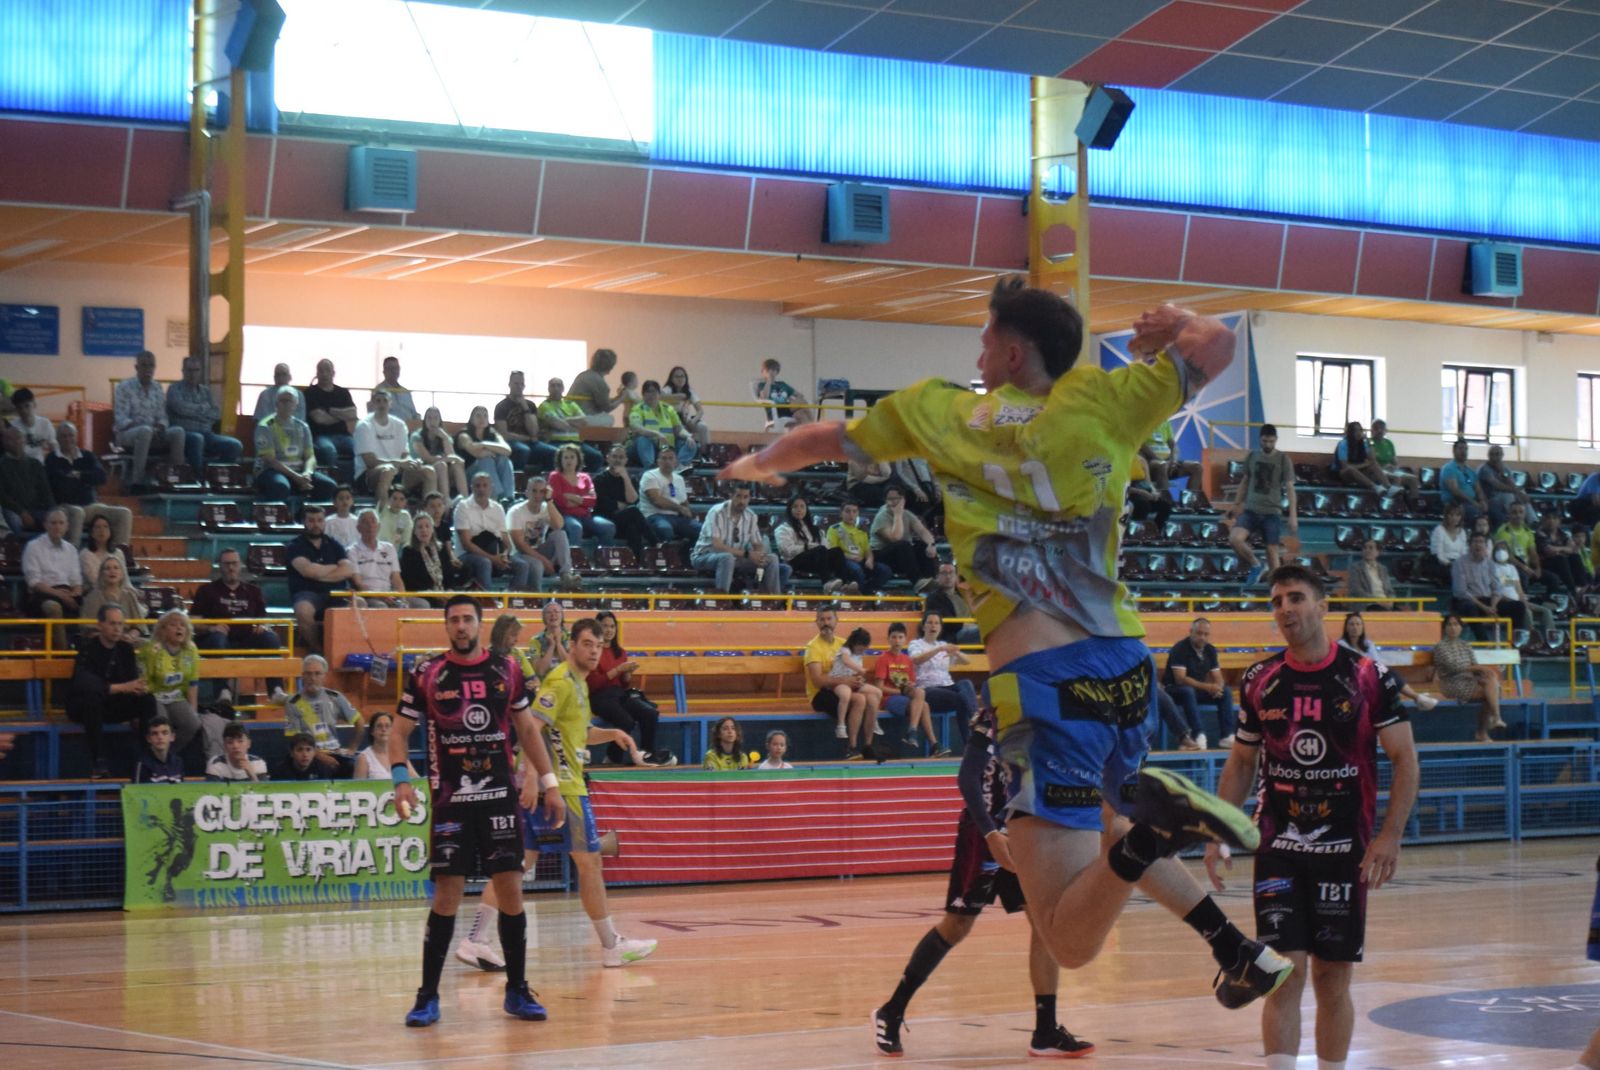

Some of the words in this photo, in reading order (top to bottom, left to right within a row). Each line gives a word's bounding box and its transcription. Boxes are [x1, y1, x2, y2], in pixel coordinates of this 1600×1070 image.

[462, 680, 487, 700] 19
[1293, 696, 1322, 722] 14
[1304, 763, 1359, 780] aranda
[450, 790, 508, 802] MICHELIN
[194, 791, 427, 831] GUERREROS
[489, 814, 516, 830] TBT
[1271, 838, 1352, 854] MICHELIN
[203, 843, 264, 880] DE
[281, 836, 428, 877] VIRIATO
[1318, 881, 1353, 902] TBT
